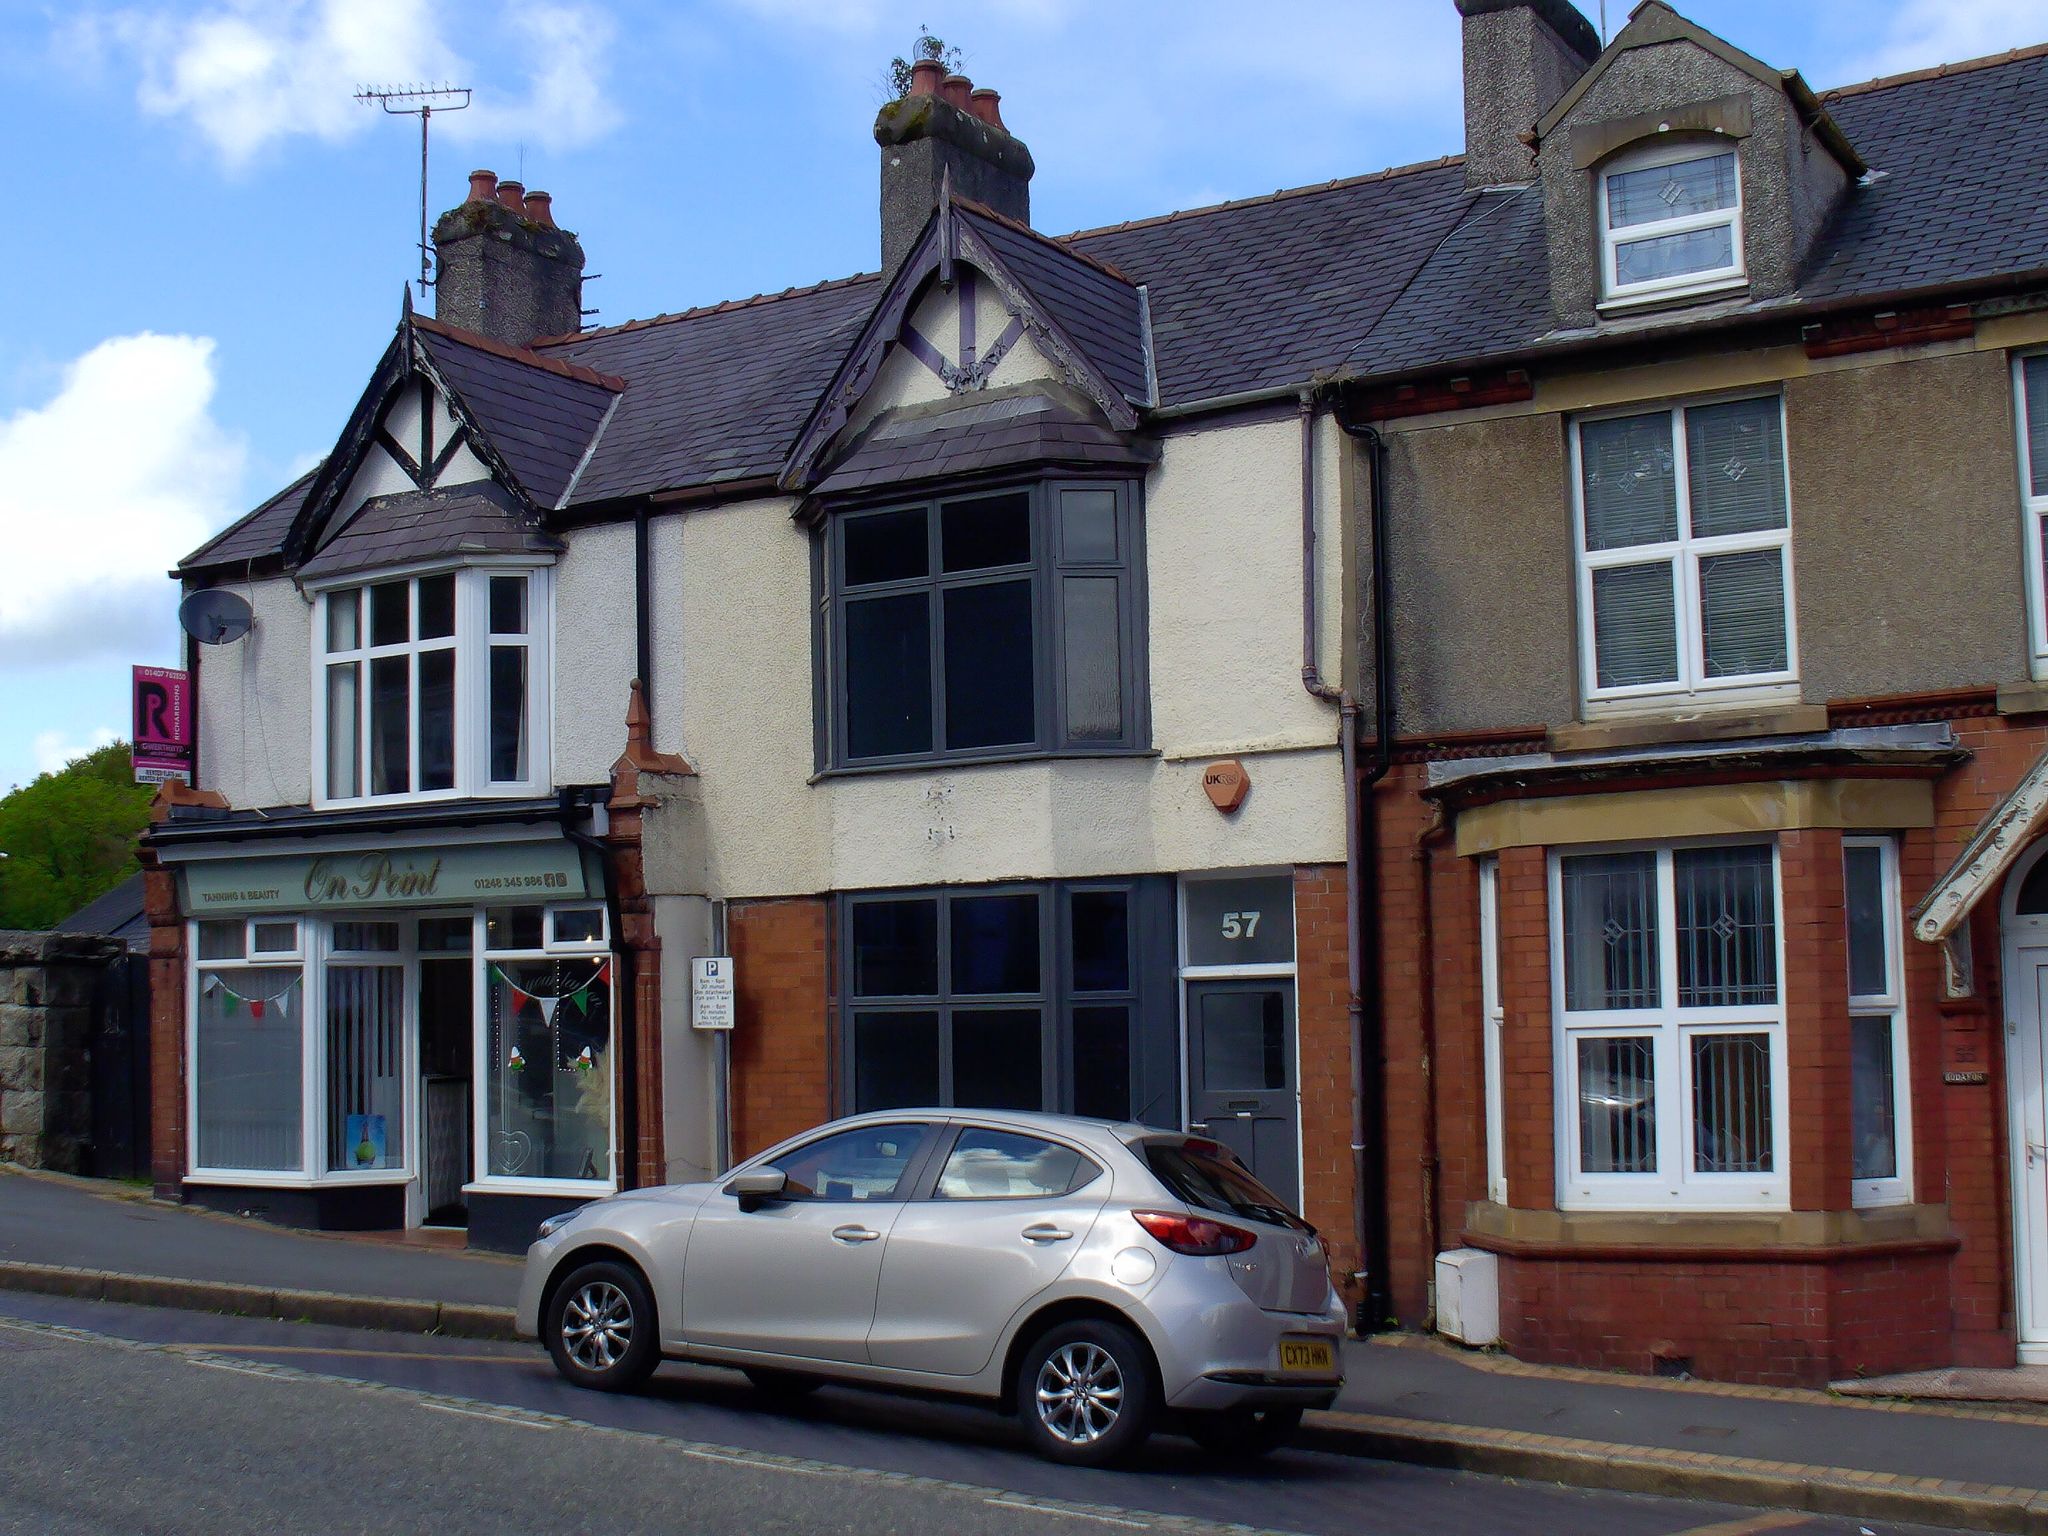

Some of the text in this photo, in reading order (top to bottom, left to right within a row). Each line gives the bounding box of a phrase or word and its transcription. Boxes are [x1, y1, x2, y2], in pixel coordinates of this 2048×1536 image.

[304, 852, 441, 903] On Point
[474, 875, 543, 889] 01248 345 986
[202, 891, 239, 902] TANNING
[248, 889, 280, 901] BEAUTY
[1221, 911, 1261, 939] 57
[708, 961, 717, 975] P
